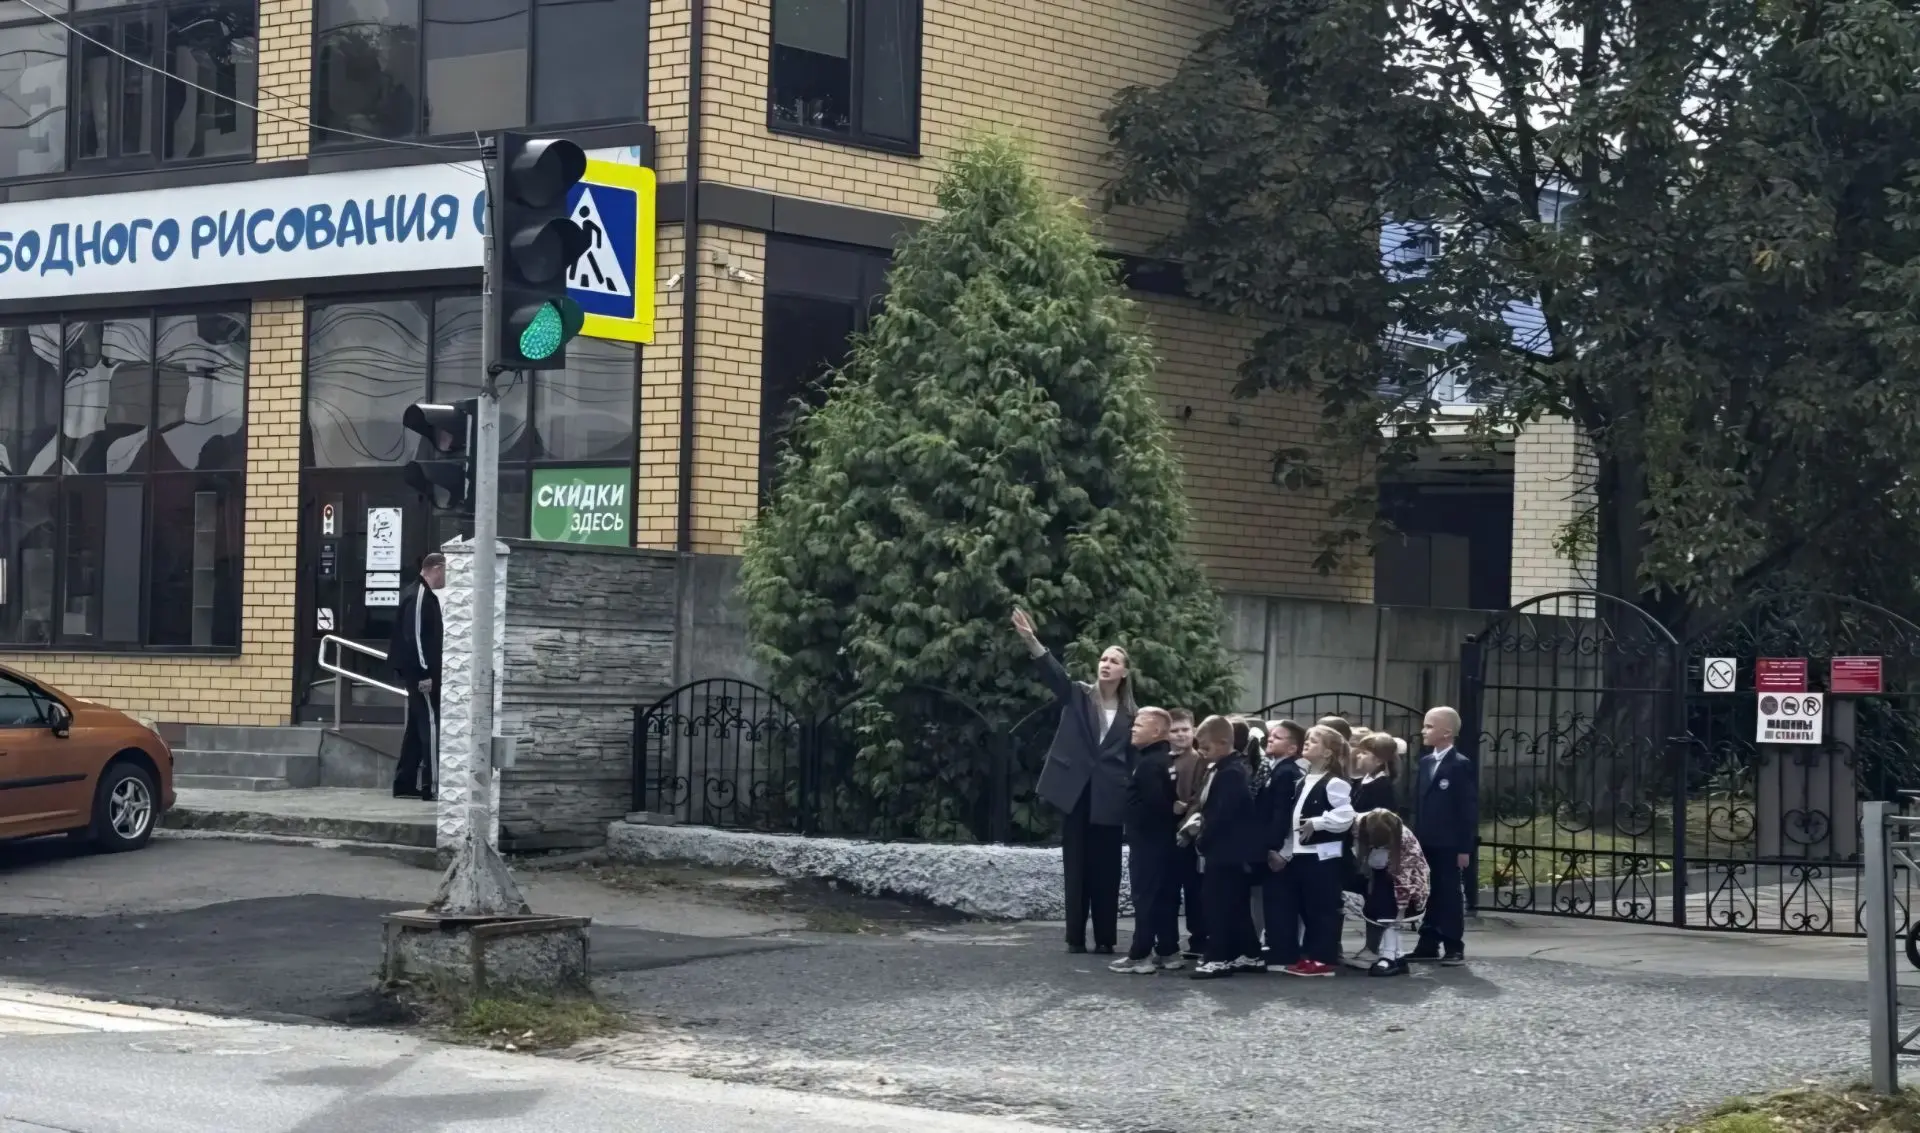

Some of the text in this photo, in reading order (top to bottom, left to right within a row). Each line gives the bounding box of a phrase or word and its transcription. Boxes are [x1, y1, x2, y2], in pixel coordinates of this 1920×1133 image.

[191, 192, 459, 260] РИСОВАНИЯ
[537, 484, 625, 510] СКИДКИ
[571, 512, 624, 535] ЗДЕСЬ
